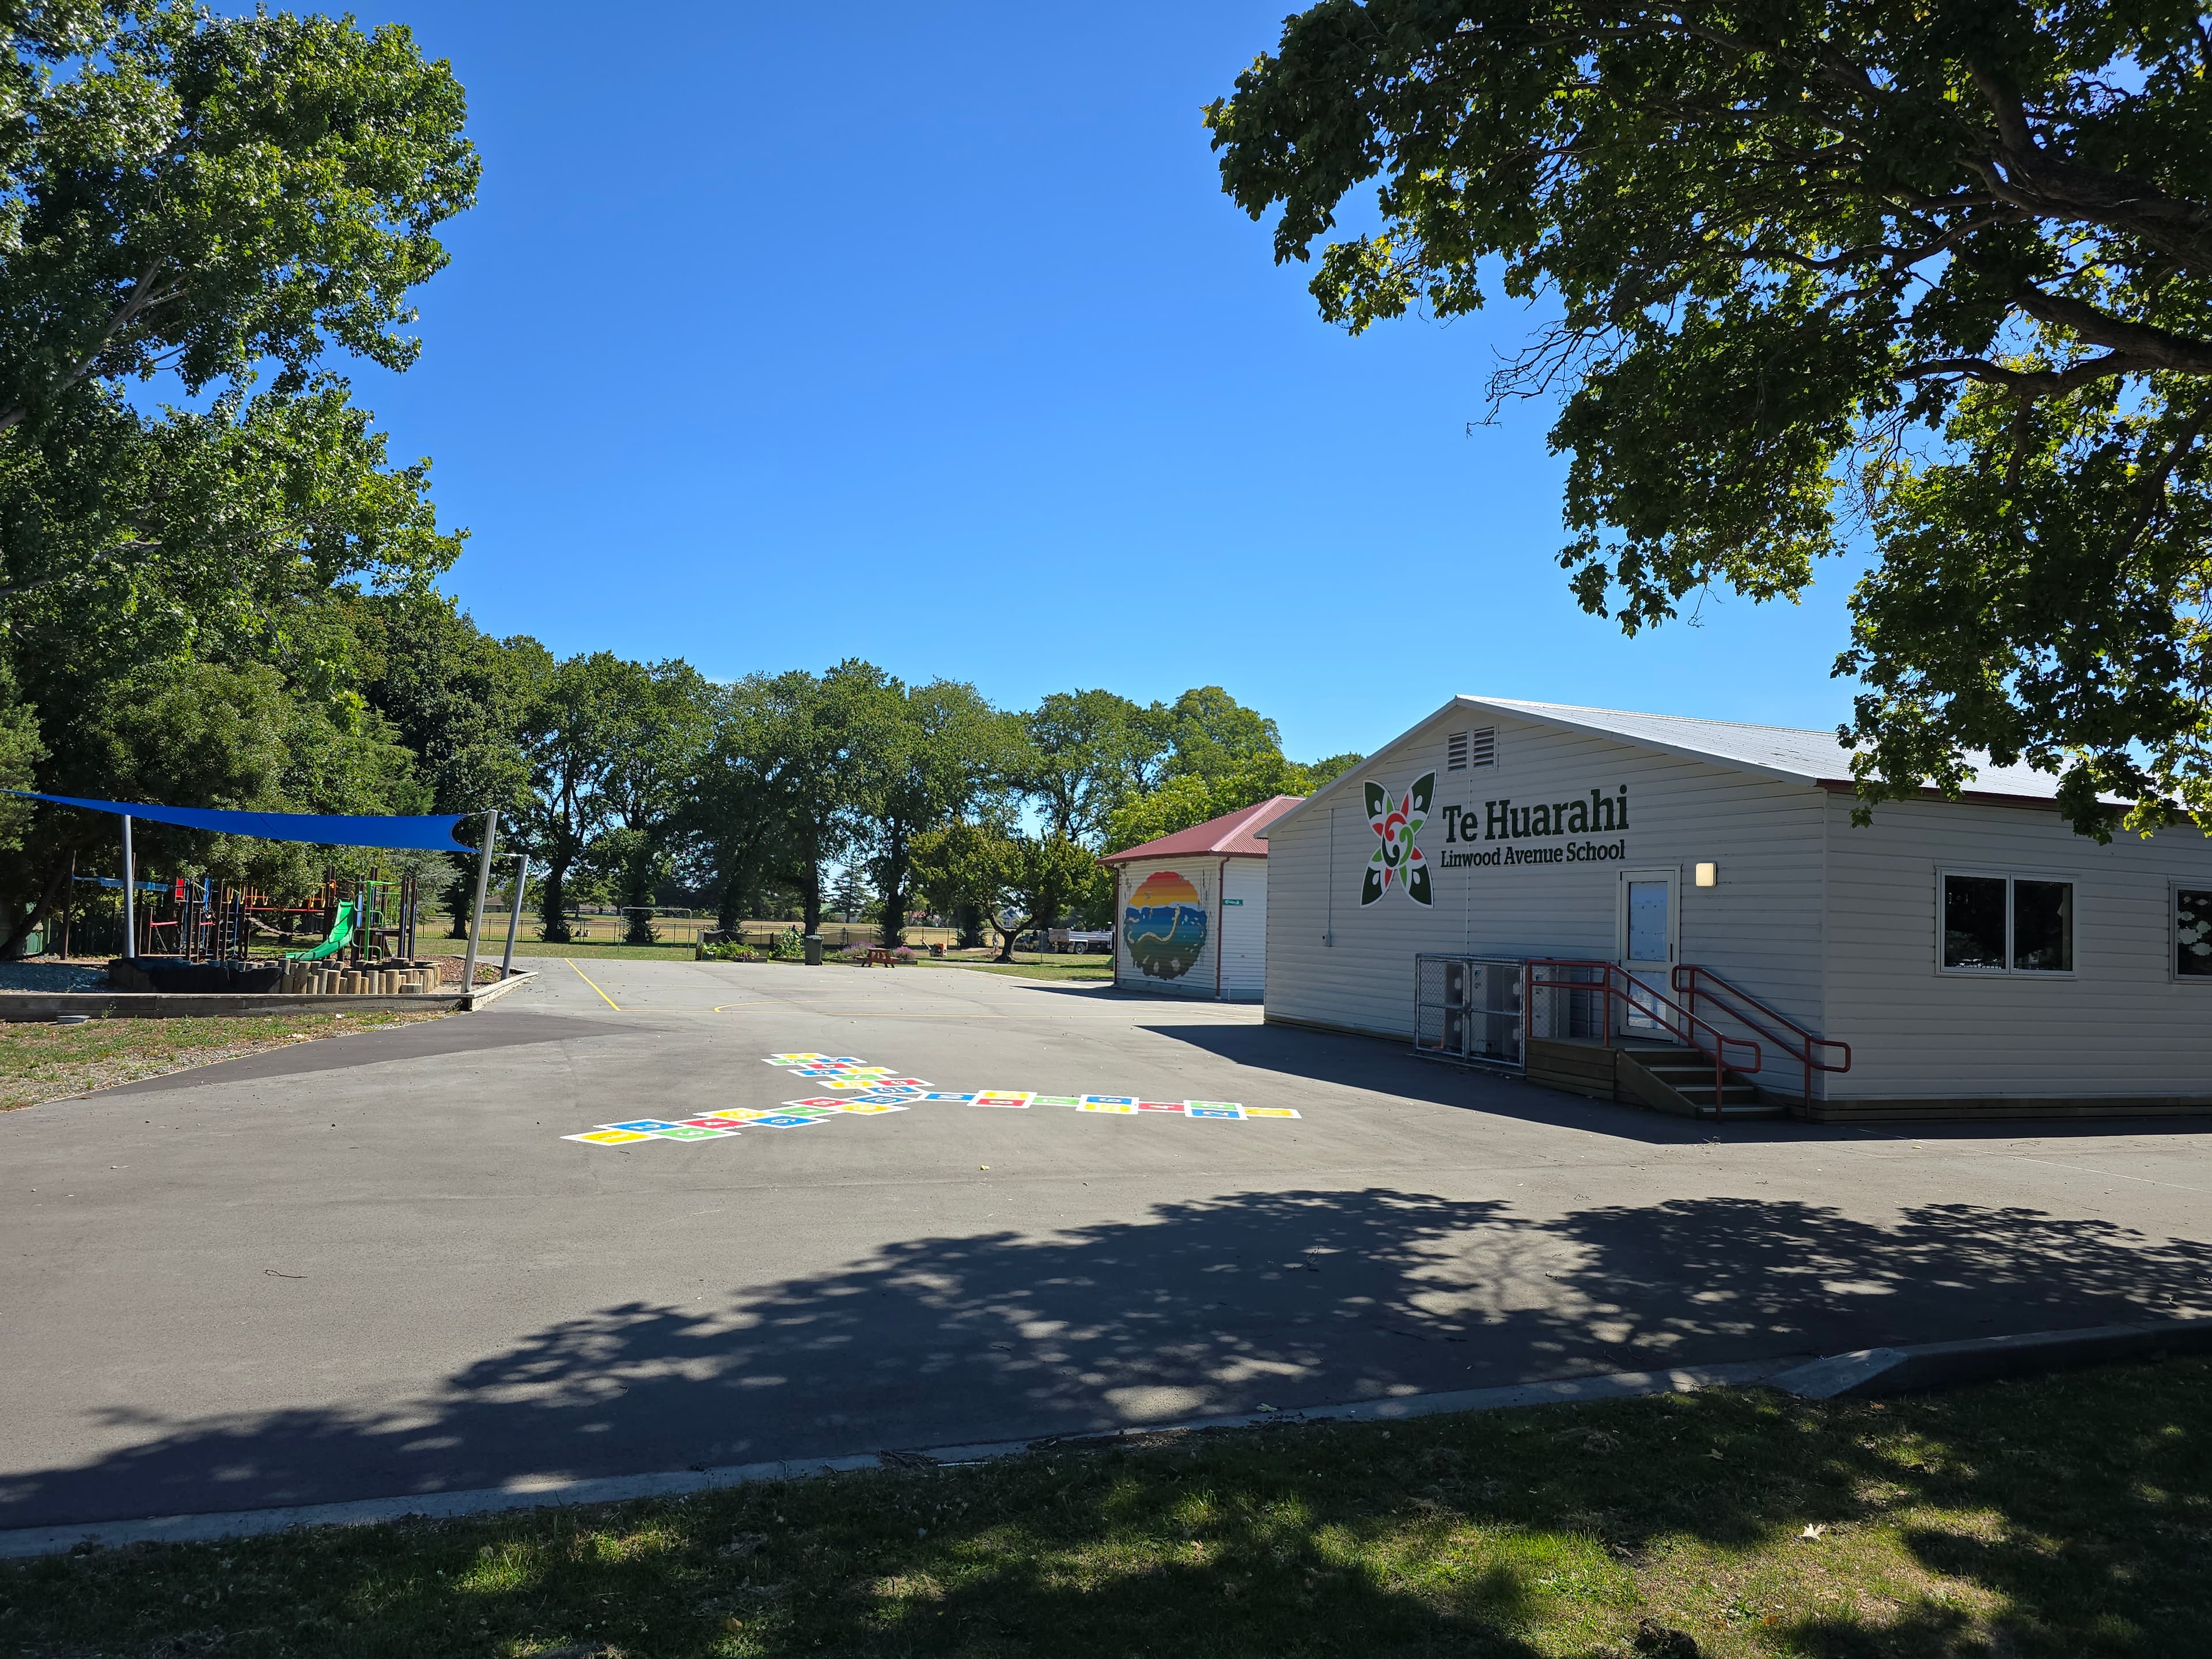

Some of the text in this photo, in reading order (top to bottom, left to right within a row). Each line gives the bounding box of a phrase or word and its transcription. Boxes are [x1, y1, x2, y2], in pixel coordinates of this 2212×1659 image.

[1442, 784, 1630, 843] Te Huarahi
[1440, 839, 1626, 868] Linwood Avenue School
